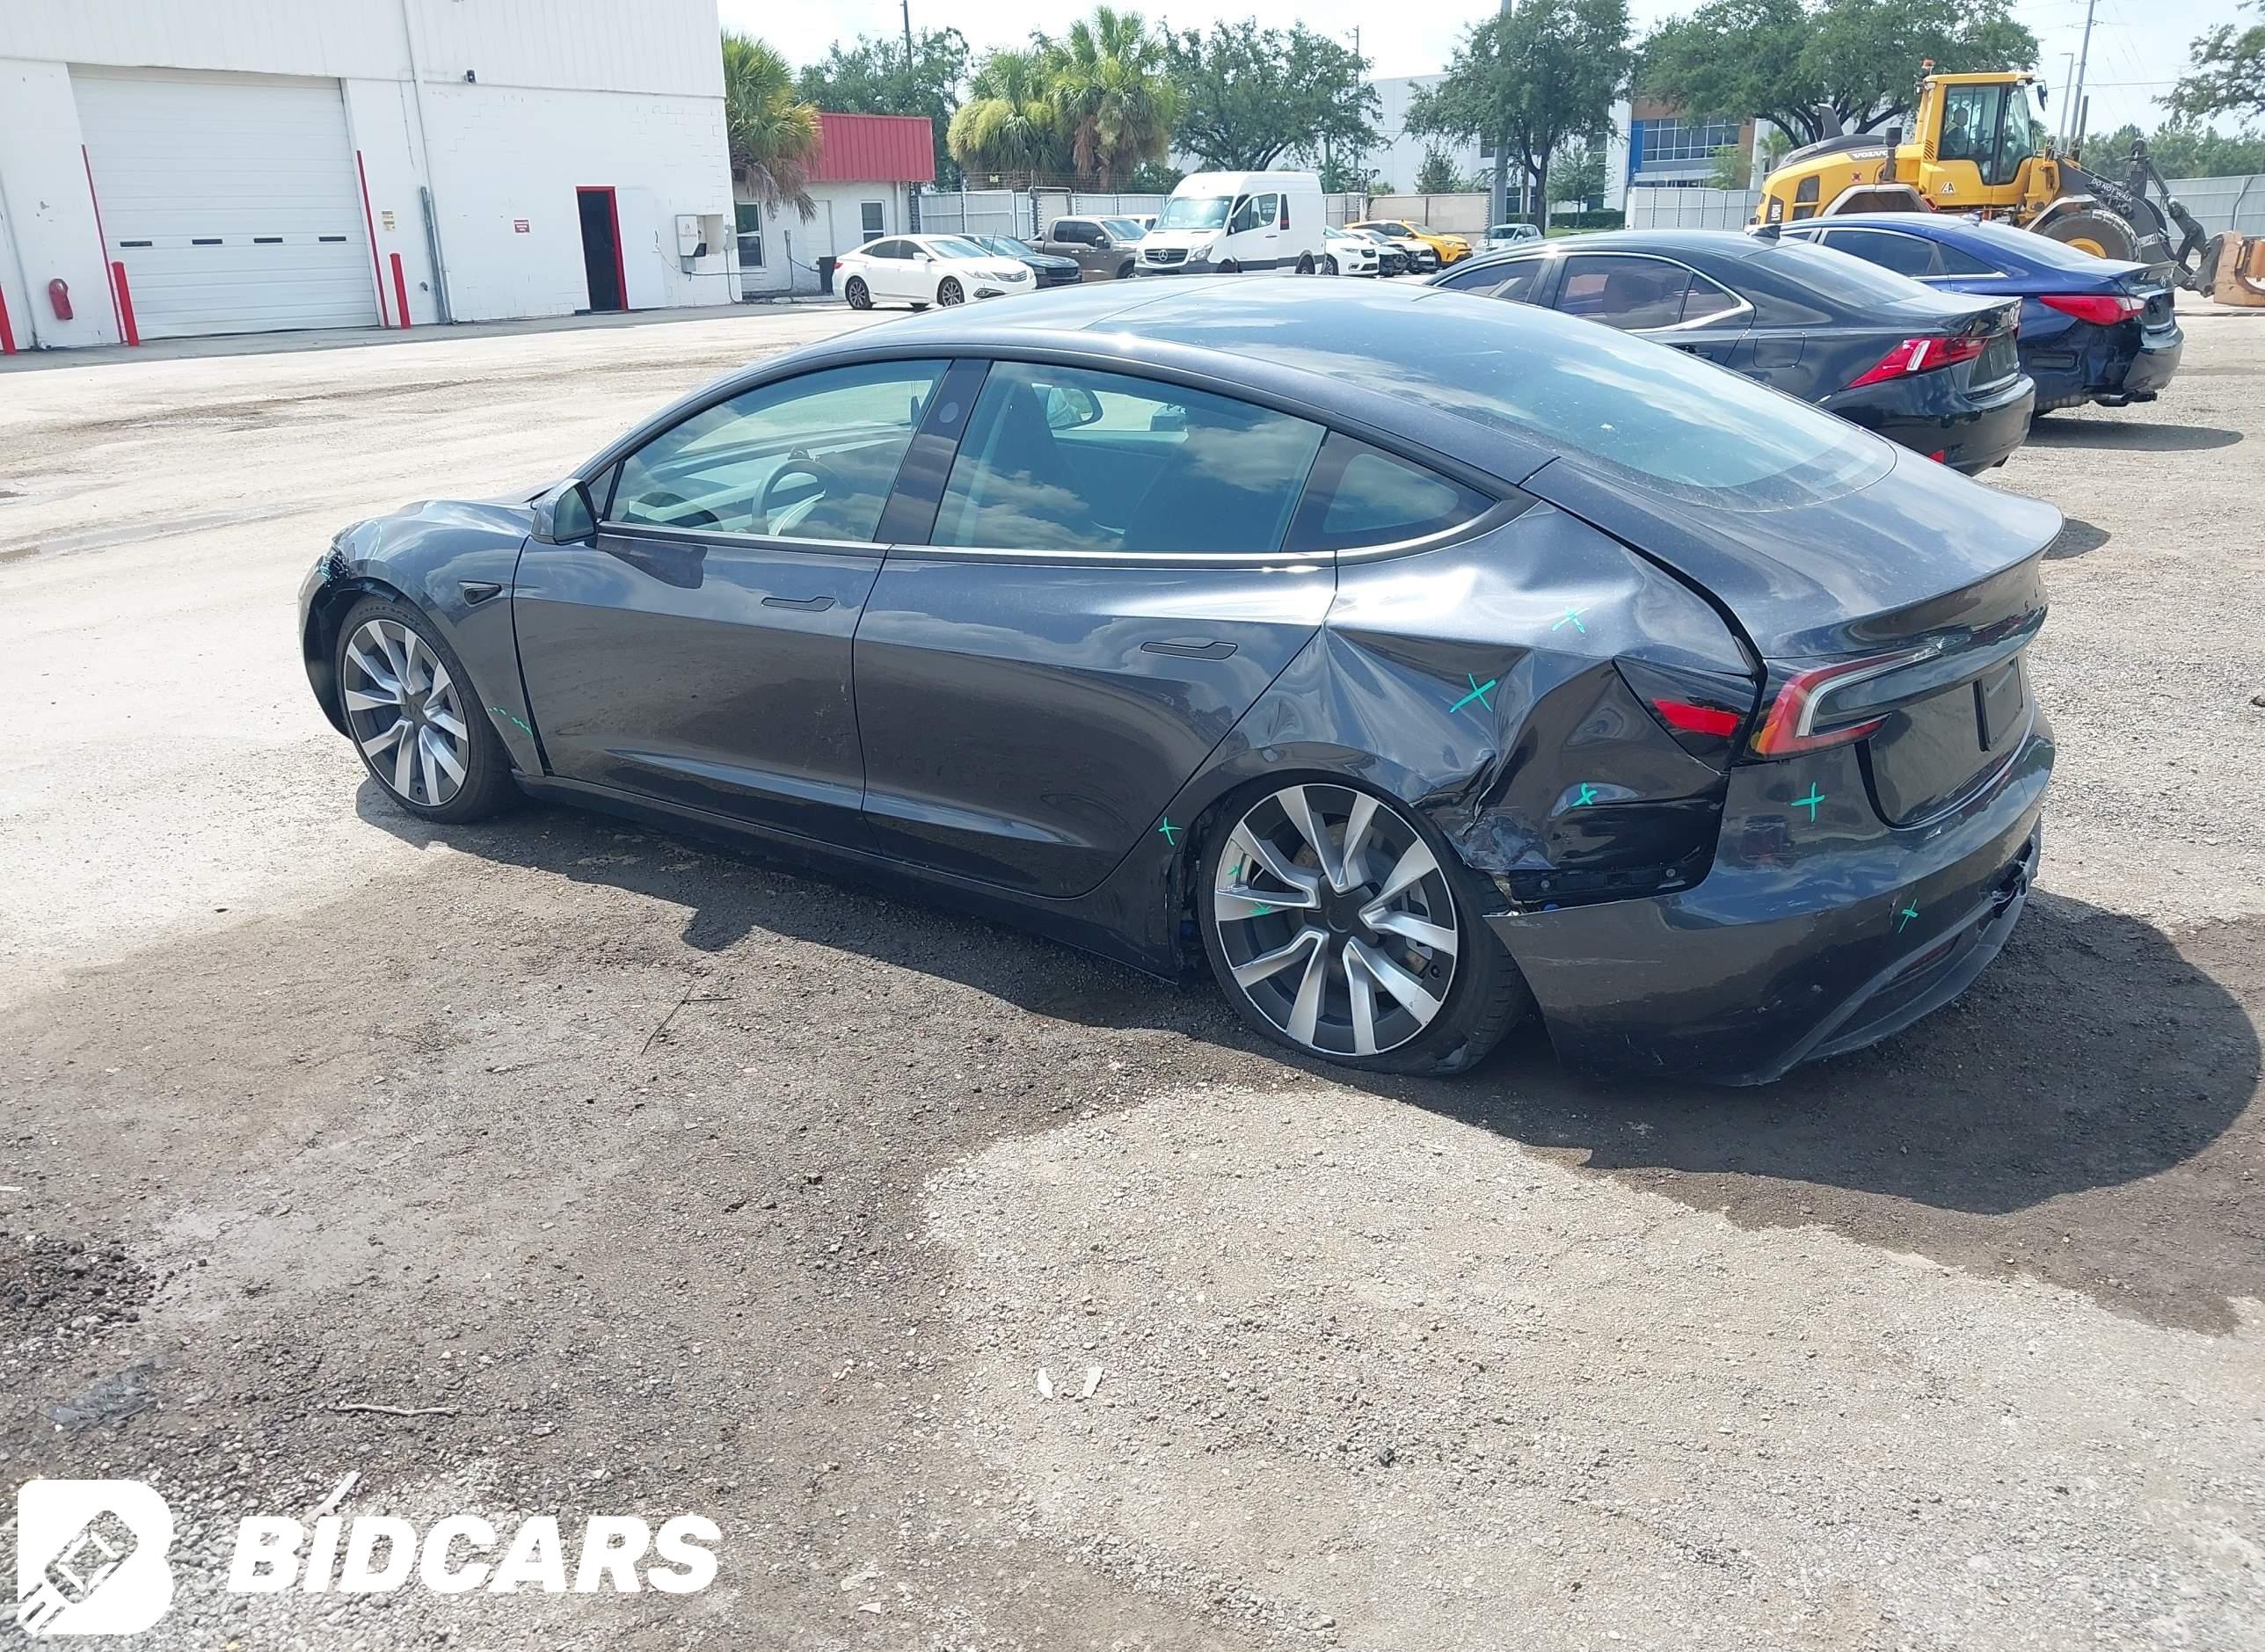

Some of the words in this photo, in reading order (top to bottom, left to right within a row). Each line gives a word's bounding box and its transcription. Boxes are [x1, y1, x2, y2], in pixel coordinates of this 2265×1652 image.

[2092, 178, 2101, 186] DO
[2102, 182, 2116, 193] NOT
[2116, 188, 2132, 202] WALK
